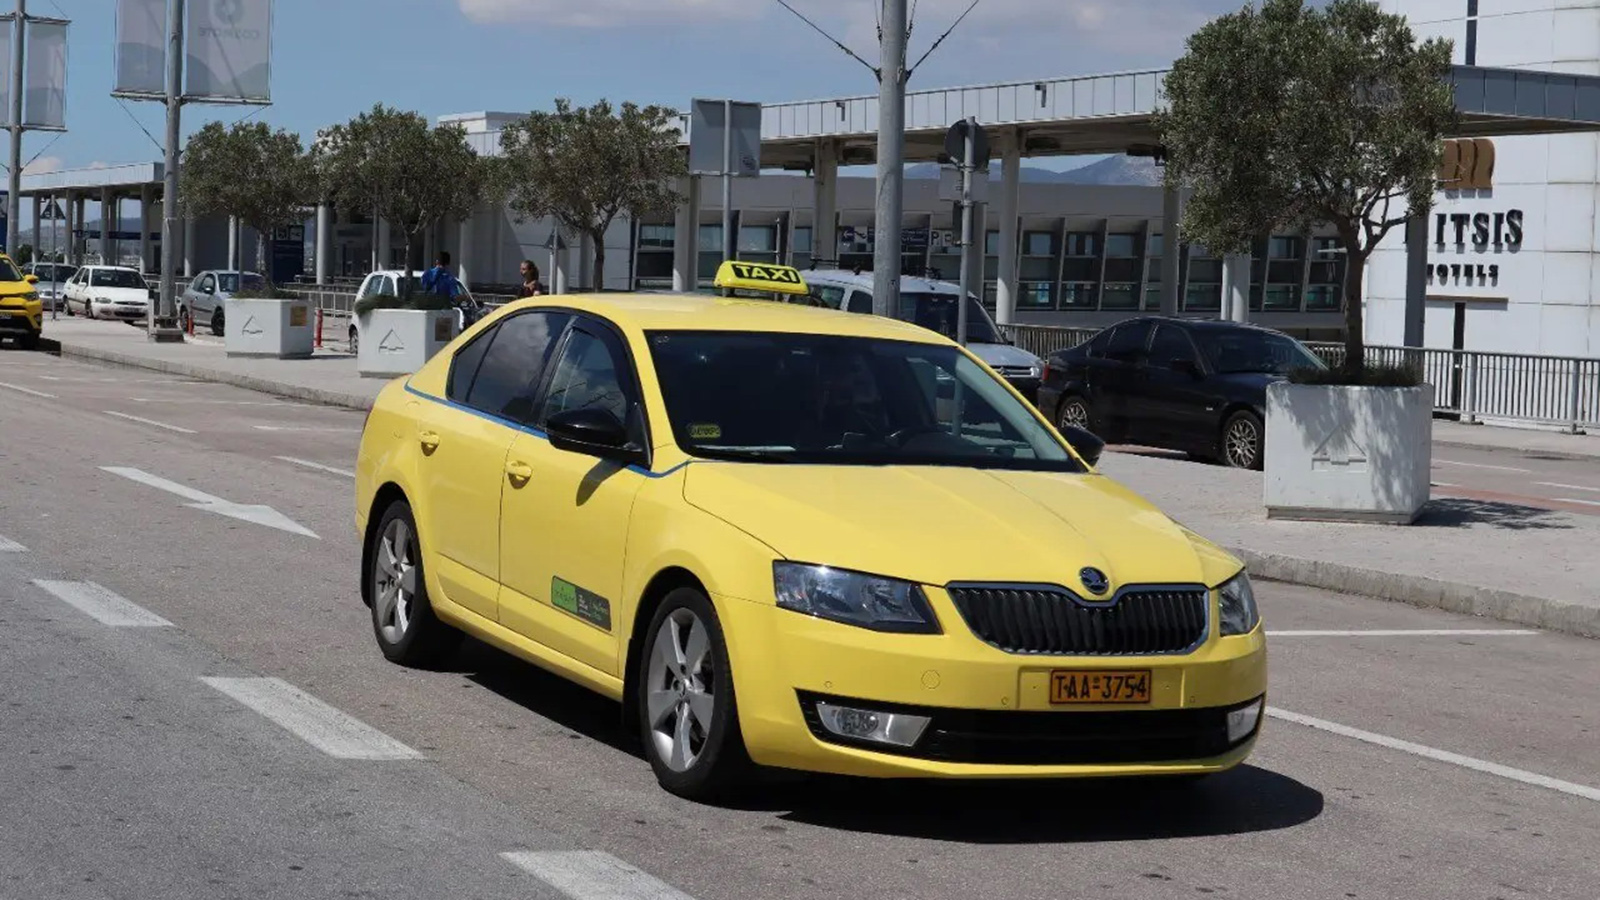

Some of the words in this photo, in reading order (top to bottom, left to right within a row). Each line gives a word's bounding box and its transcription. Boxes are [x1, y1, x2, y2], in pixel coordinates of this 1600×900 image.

[1403, 209, 1523, 246] ITSIS
[736, 265, 797, 282] TAXI
[1055, 675, 1147, 699] TAA-3754
